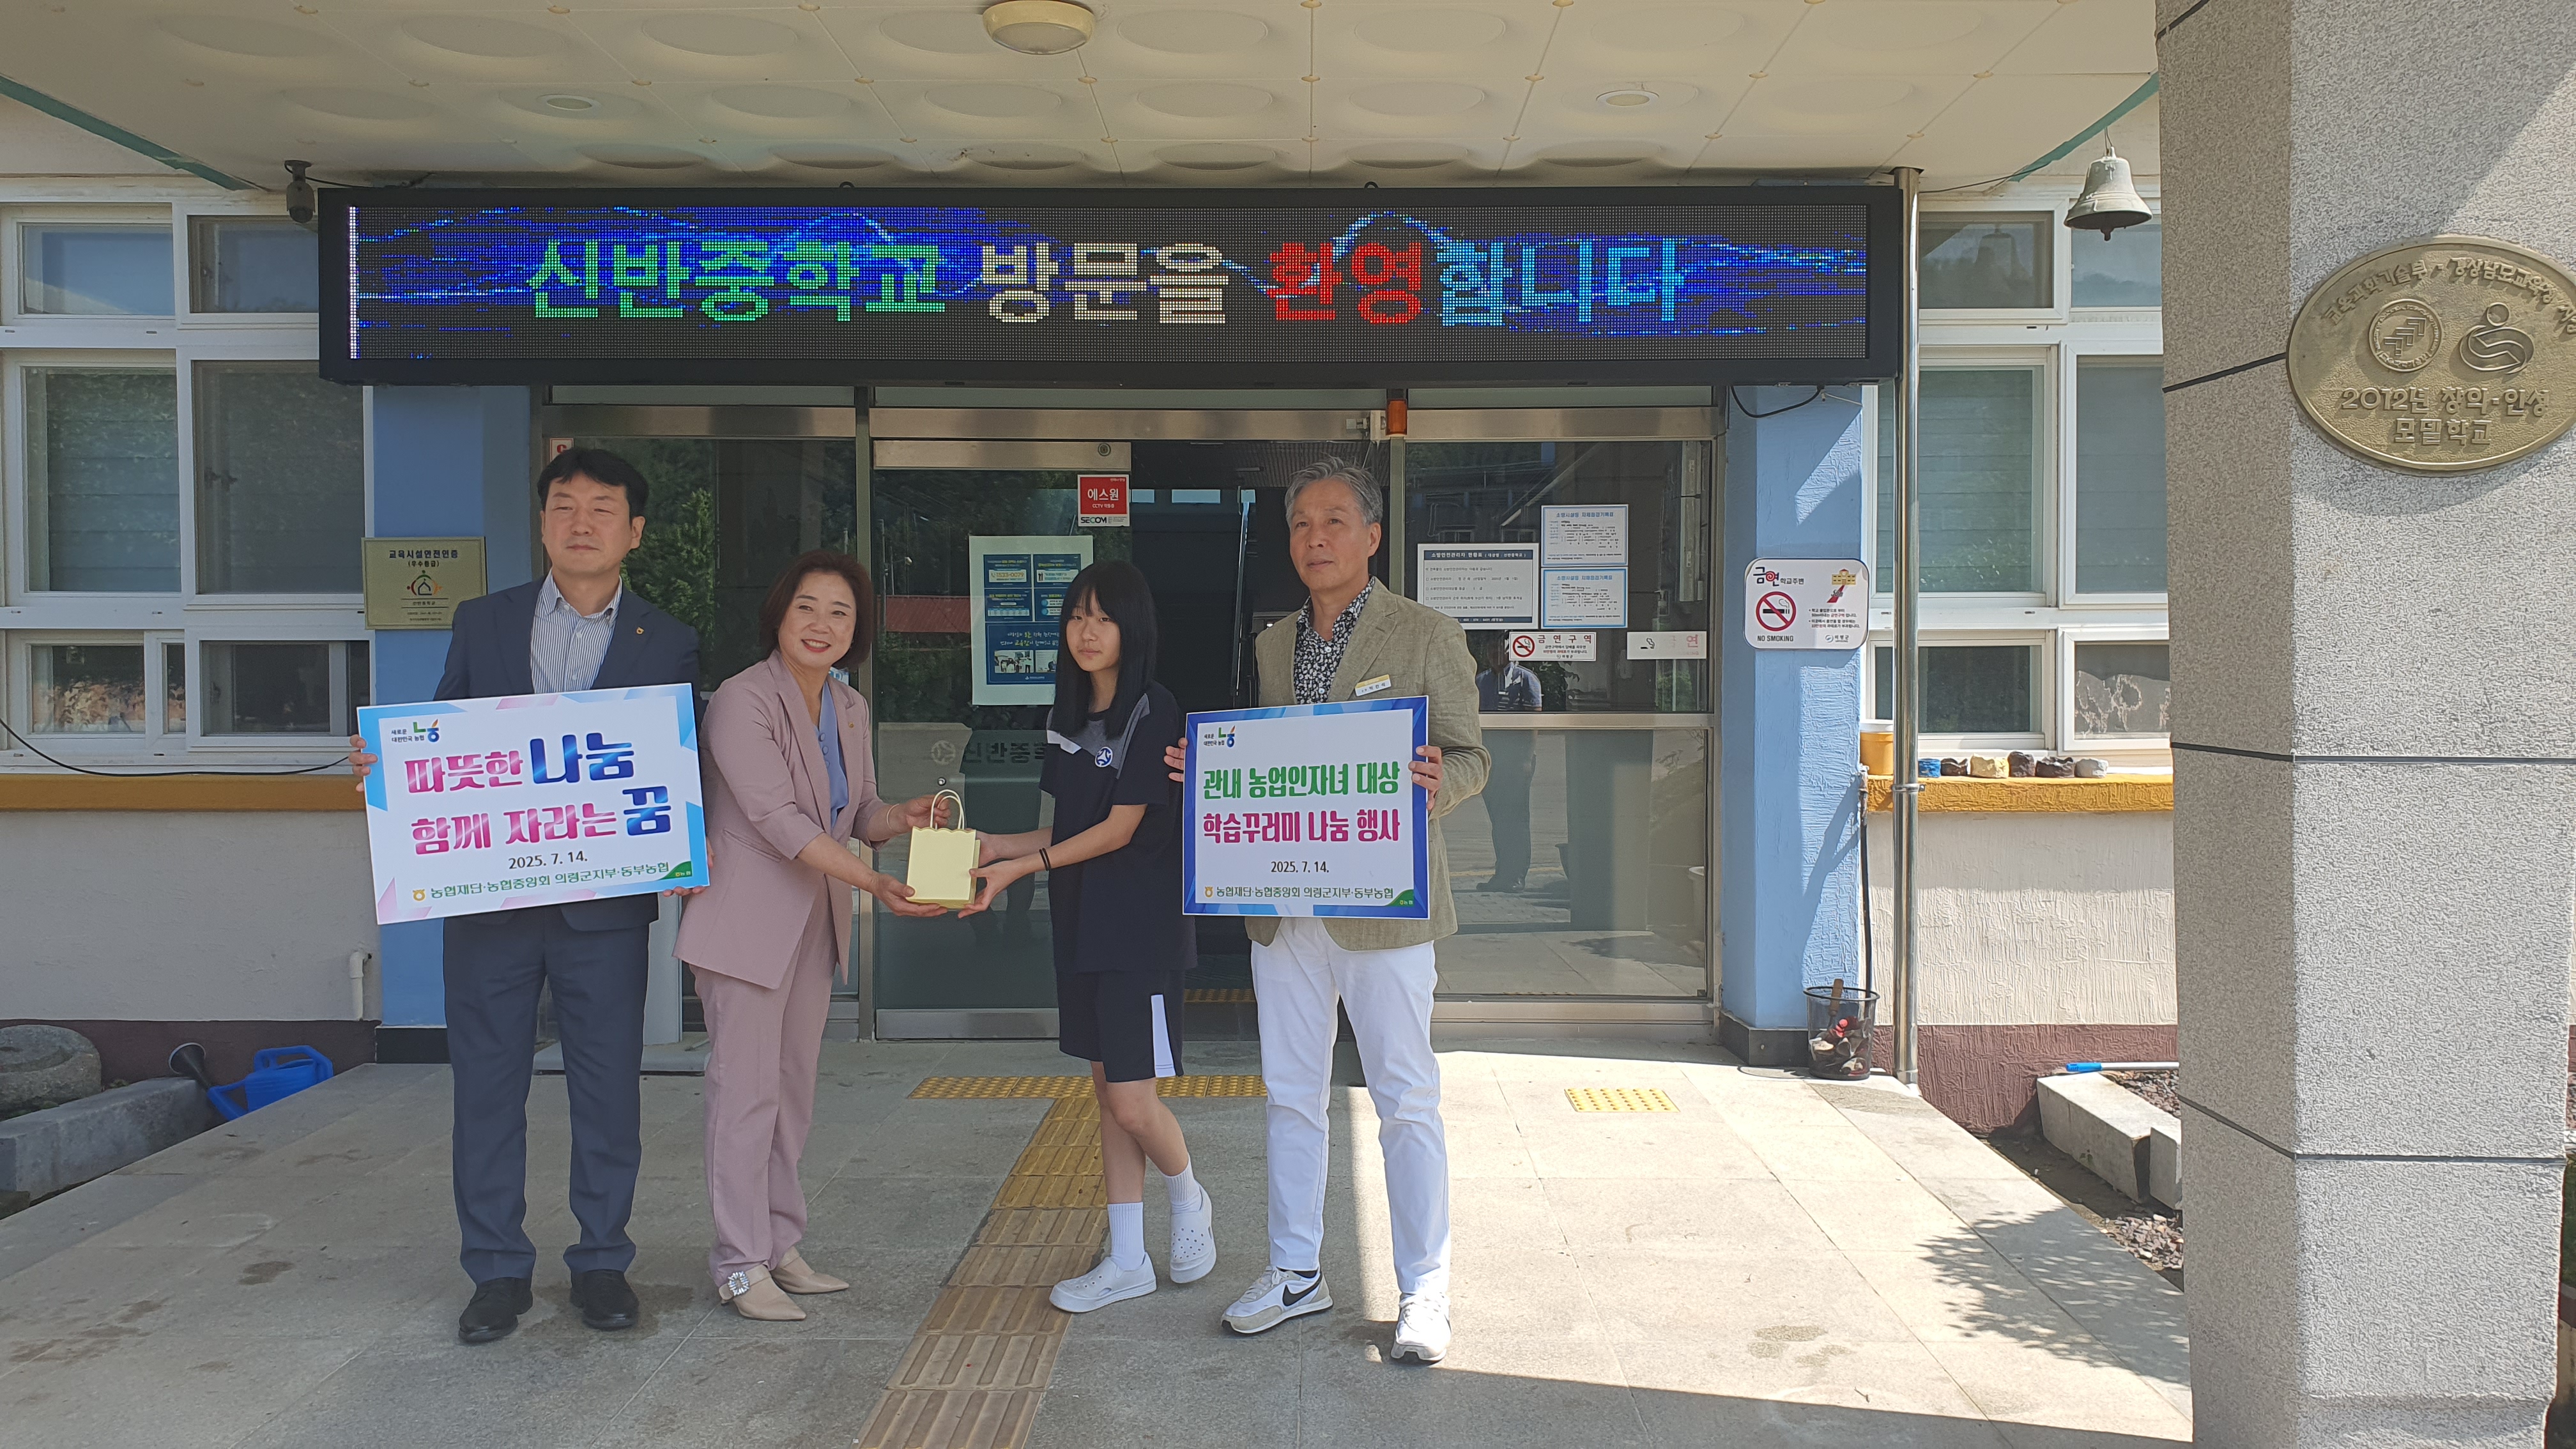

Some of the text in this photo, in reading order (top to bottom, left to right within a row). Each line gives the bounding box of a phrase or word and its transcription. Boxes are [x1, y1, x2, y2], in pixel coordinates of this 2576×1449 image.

[526, 238, 1685, 326] 신반중학교 방문을 환영합니다
[2340, 387, 2429, 414] 2012년
[2394, 418, 2491, 445] 모델학교
[1087, 488, 1119, 501] 에스원
[389, 549, 458, 558] 교육시설안전인증
[404, 732, 635, 794] 따뜻한 나눔
[1203, 761, 1400, 799] 관내 농업인자녀 대상
[410, 785, 672, 855] 함께 자라는 꿈
[1203, 809, 1400, 843] 학습꾸러미 나눔 행사
[508, 850, 588, 870] 2025. 7. 14.
[1271, 861, 1330, 873] 2025. 7. 14.
